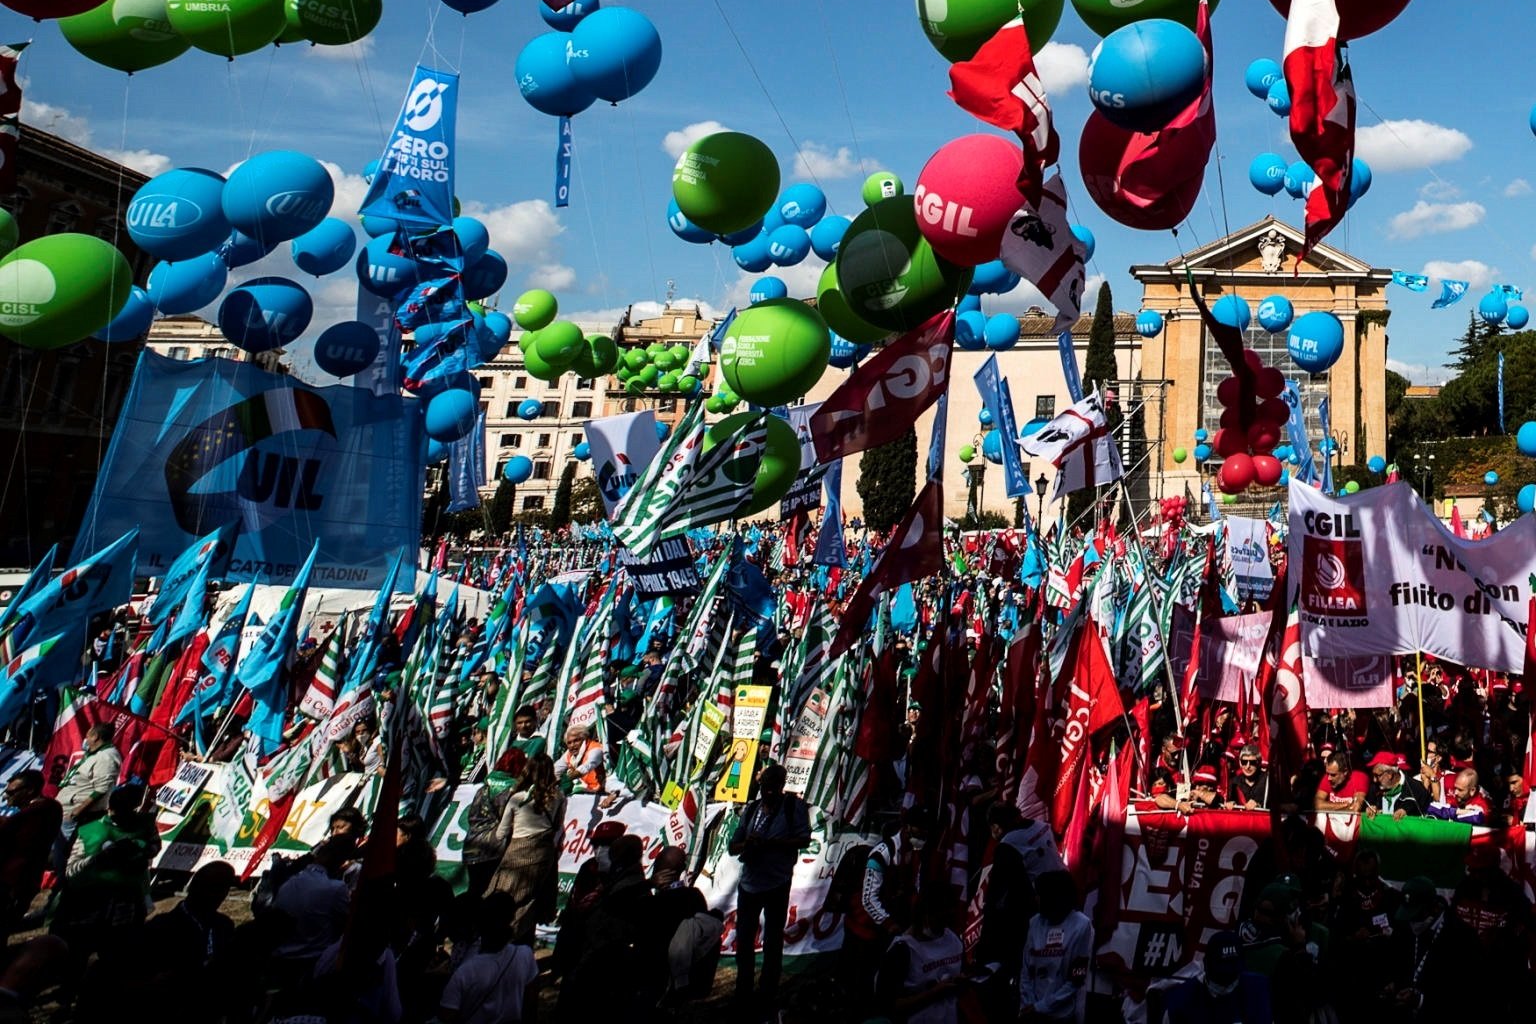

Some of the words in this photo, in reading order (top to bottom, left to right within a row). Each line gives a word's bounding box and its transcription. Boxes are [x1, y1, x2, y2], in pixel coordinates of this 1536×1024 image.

[185, 3, 231, 13] UMBRIA
[308, 0, 353, 22] CISL
[420, 157, 449, 171] SUL
[128, 203, 177, 228] UILA
[914, 184, 979, 238] CGIL
[2, 304, 40, 314] CISL
[1136, 320, 1158, 333] UIL
[326, 345, 367, 360] UIL
[247, 448, 326, 511] UIL
[1304, 511, 1360, 537] CGIL
[662, 539, 688, 561] DAL
[149, 555, 166, 568] IL
[667, 567, 698, 590] 1945
[1308, 595, 1357, 610] FILLEA
[1328, 615, 1335, 626] E
[1337, 616, 1369, 627] LAZIO
[1060, 705, 1090, 763] CGIL
